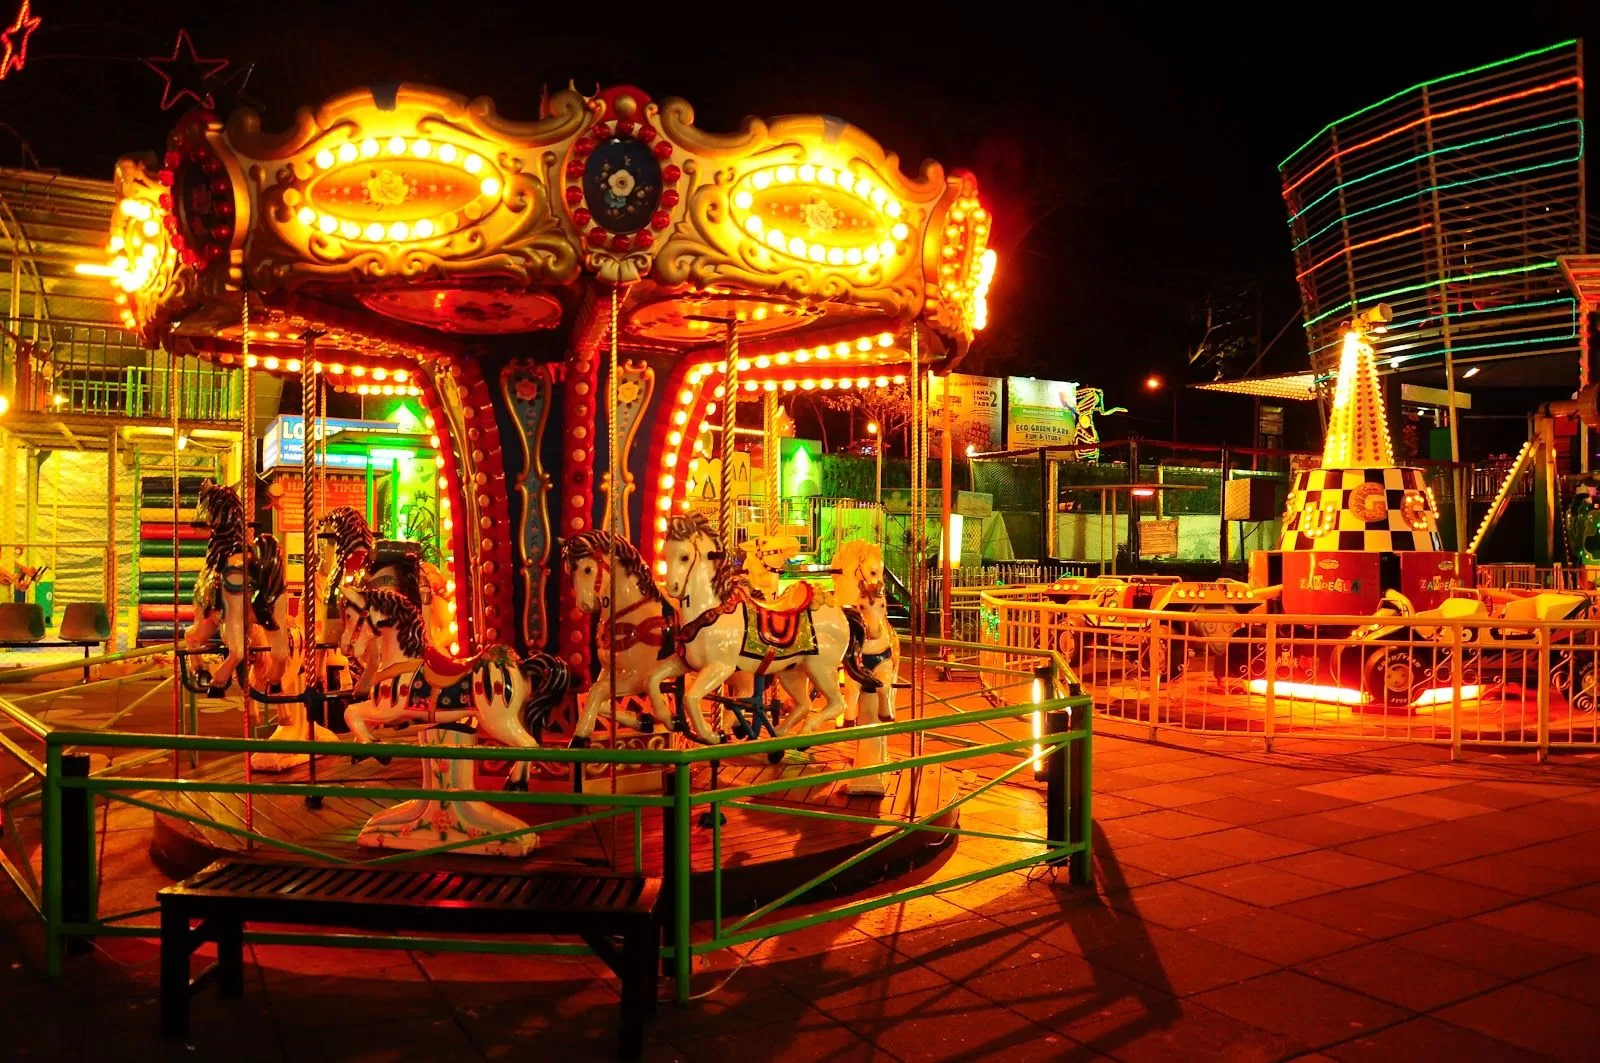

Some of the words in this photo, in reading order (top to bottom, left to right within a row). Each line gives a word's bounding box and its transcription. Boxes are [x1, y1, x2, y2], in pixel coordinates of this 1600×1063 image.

[989, 390, 998, 408] 2
[1052, 426, 1070, 435] PARK
[287, 481, 330, 492] HAGA
